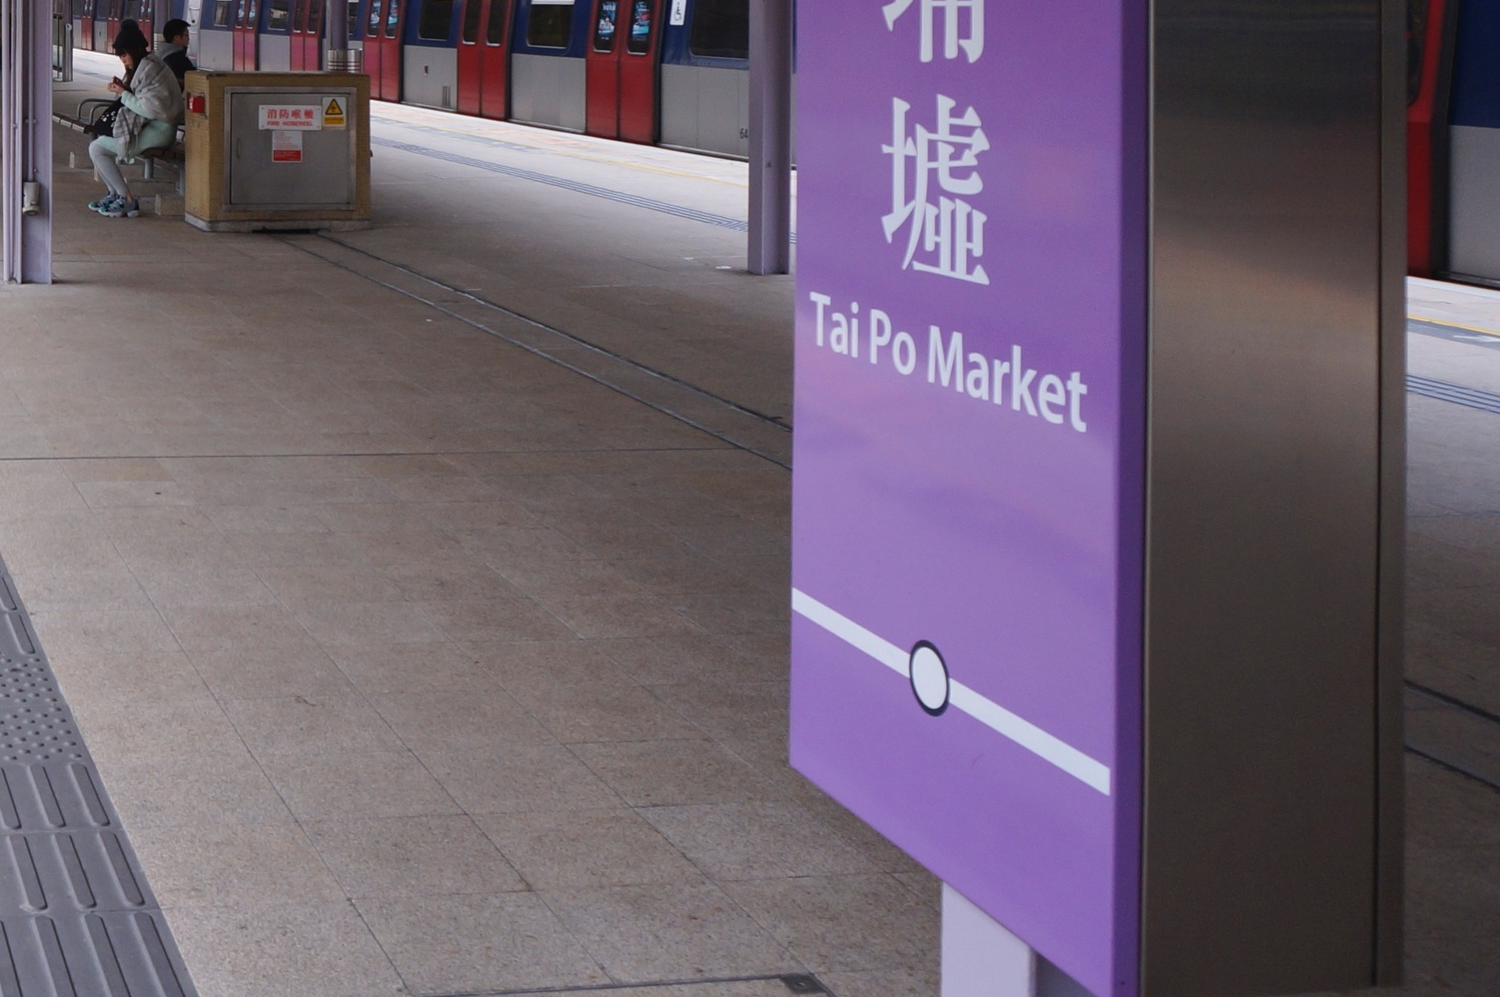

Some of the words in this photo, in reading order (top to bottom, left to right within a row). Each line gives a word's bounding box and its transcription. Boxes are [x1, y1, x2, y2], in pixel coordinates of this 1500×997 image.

[810, 291, 859, 359] Tai
[869, 308, 916, 376] Po
[927, 324, 1088, 433] Market
